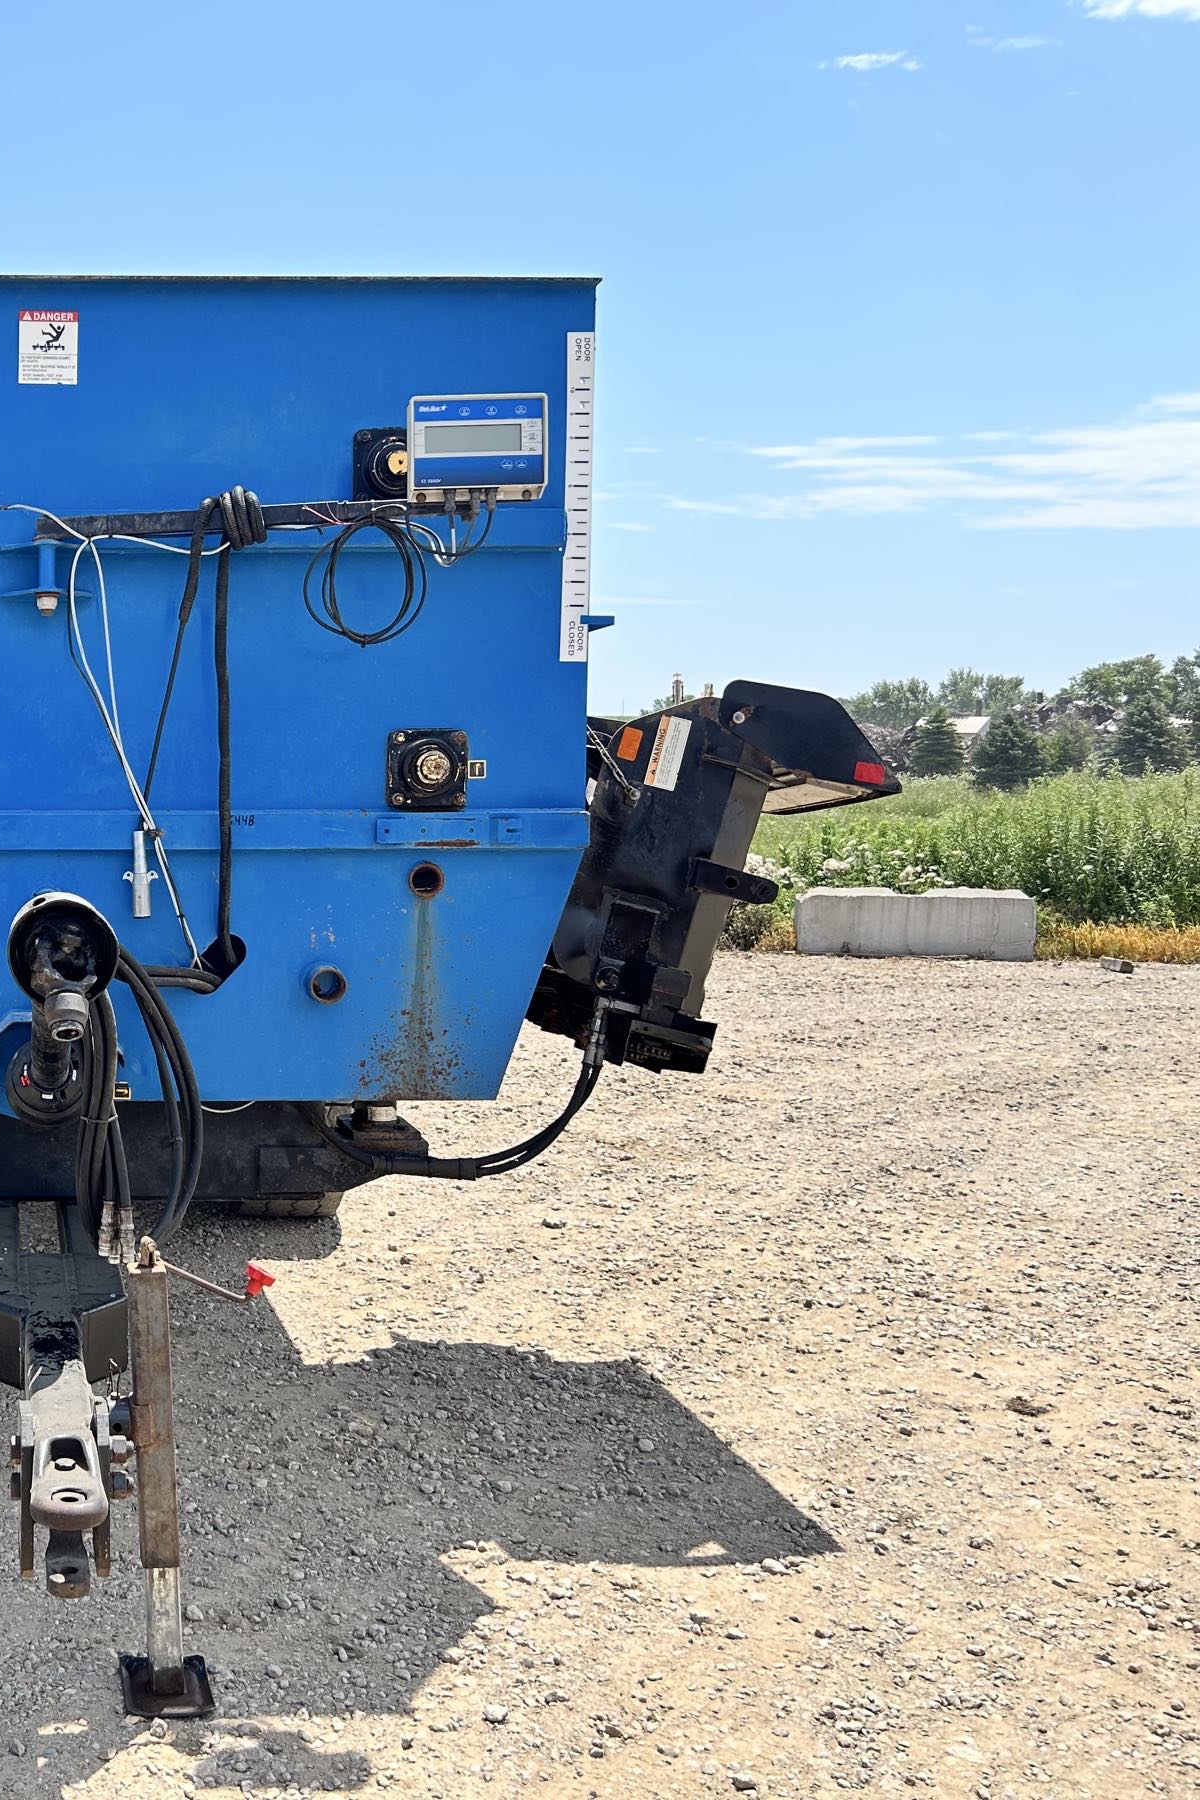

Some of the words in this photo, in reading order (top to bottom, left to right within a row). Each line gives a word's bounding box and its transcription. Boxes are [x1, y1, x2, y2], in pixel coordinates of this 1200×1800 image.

[33, 312, 74, 321] DANGER
[651, 728, 666, 763] WARNING
[230, 814, 255, 827] 448
